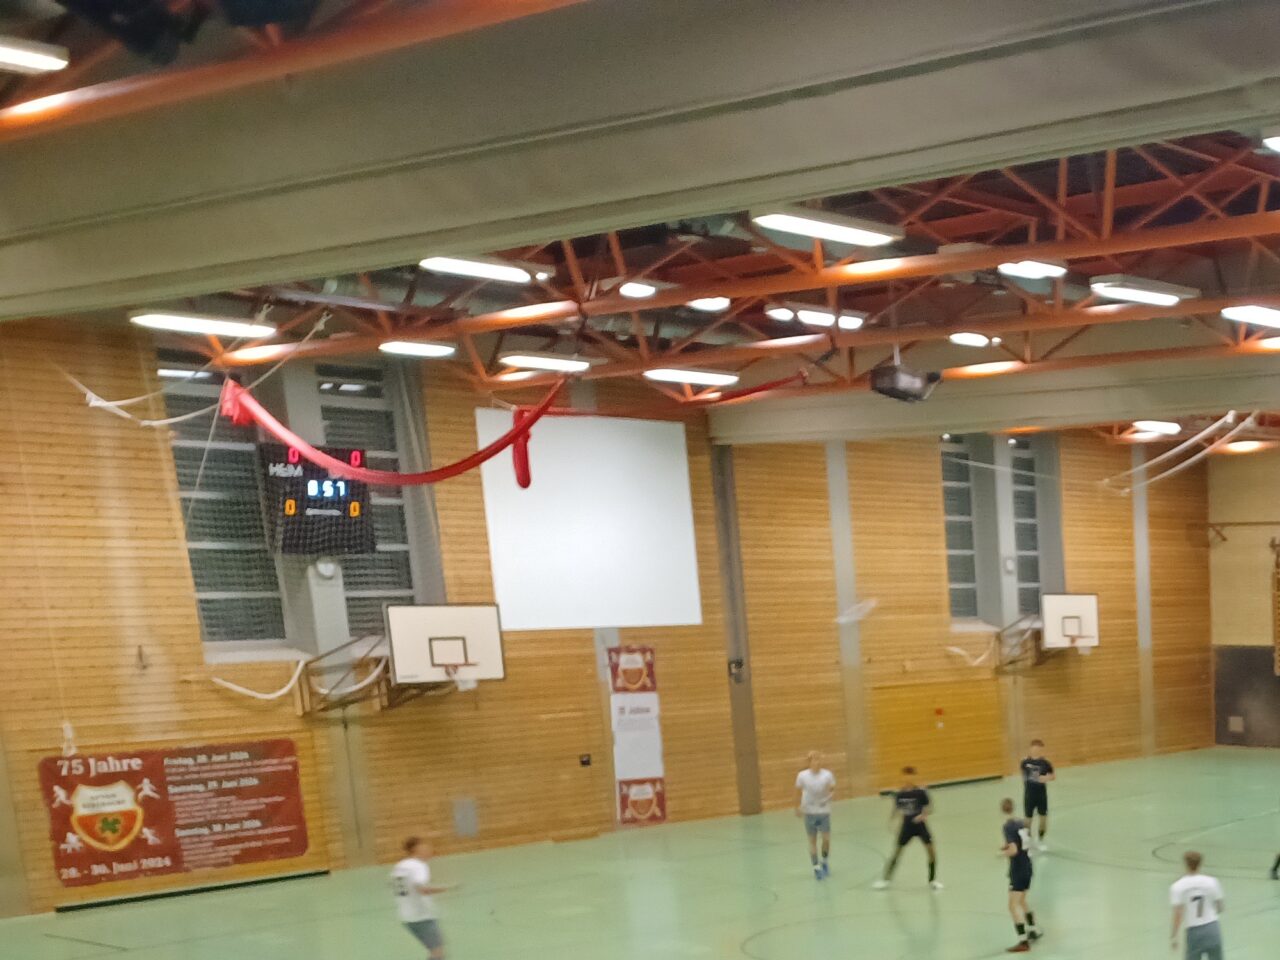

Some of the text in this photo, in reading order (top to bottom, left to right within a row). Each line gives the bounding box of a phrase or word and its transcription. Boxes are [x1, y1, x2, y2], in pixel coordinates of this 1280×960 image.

[284, 499, 296, 516] 0
[350, 501, 361, 517] 0
[57, 759, 85, 776] 75
[88, 756, 144, 778] Jahre
[1190, 895, 1204, 918] 7
